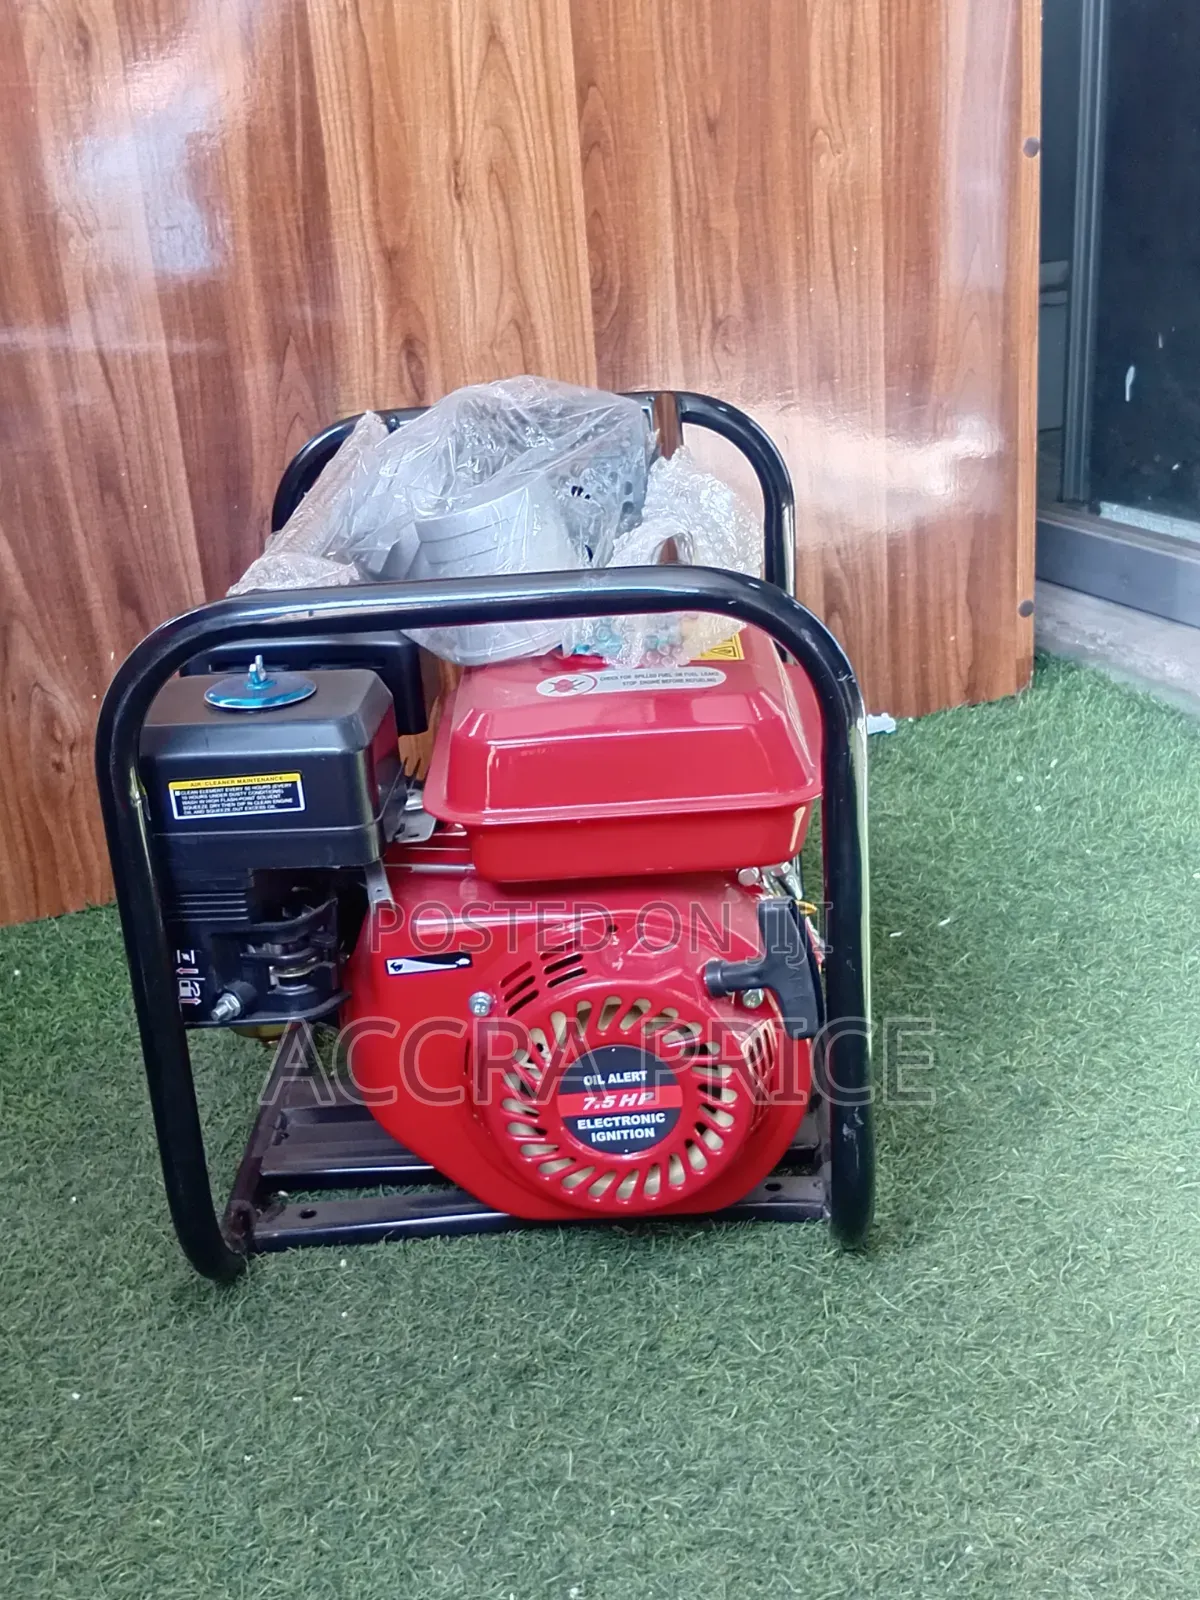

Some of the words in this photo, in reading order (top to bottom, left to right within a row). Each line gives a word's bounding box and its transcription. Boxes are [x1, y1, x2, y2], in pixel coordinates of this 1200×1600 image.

[236, 775, 284, 784] MAINTENANCE
[583, 1074, 606, 1086] OIL
[607, 1070, 648, 1084] ALERT
[582, 1094, 617, 1111] 7.5
[618, 1092, 655, 1108] HP
[577, 1112, 666, 1130] ELECTRONIC
[591, 1127, 656, 1142] IGNITION
